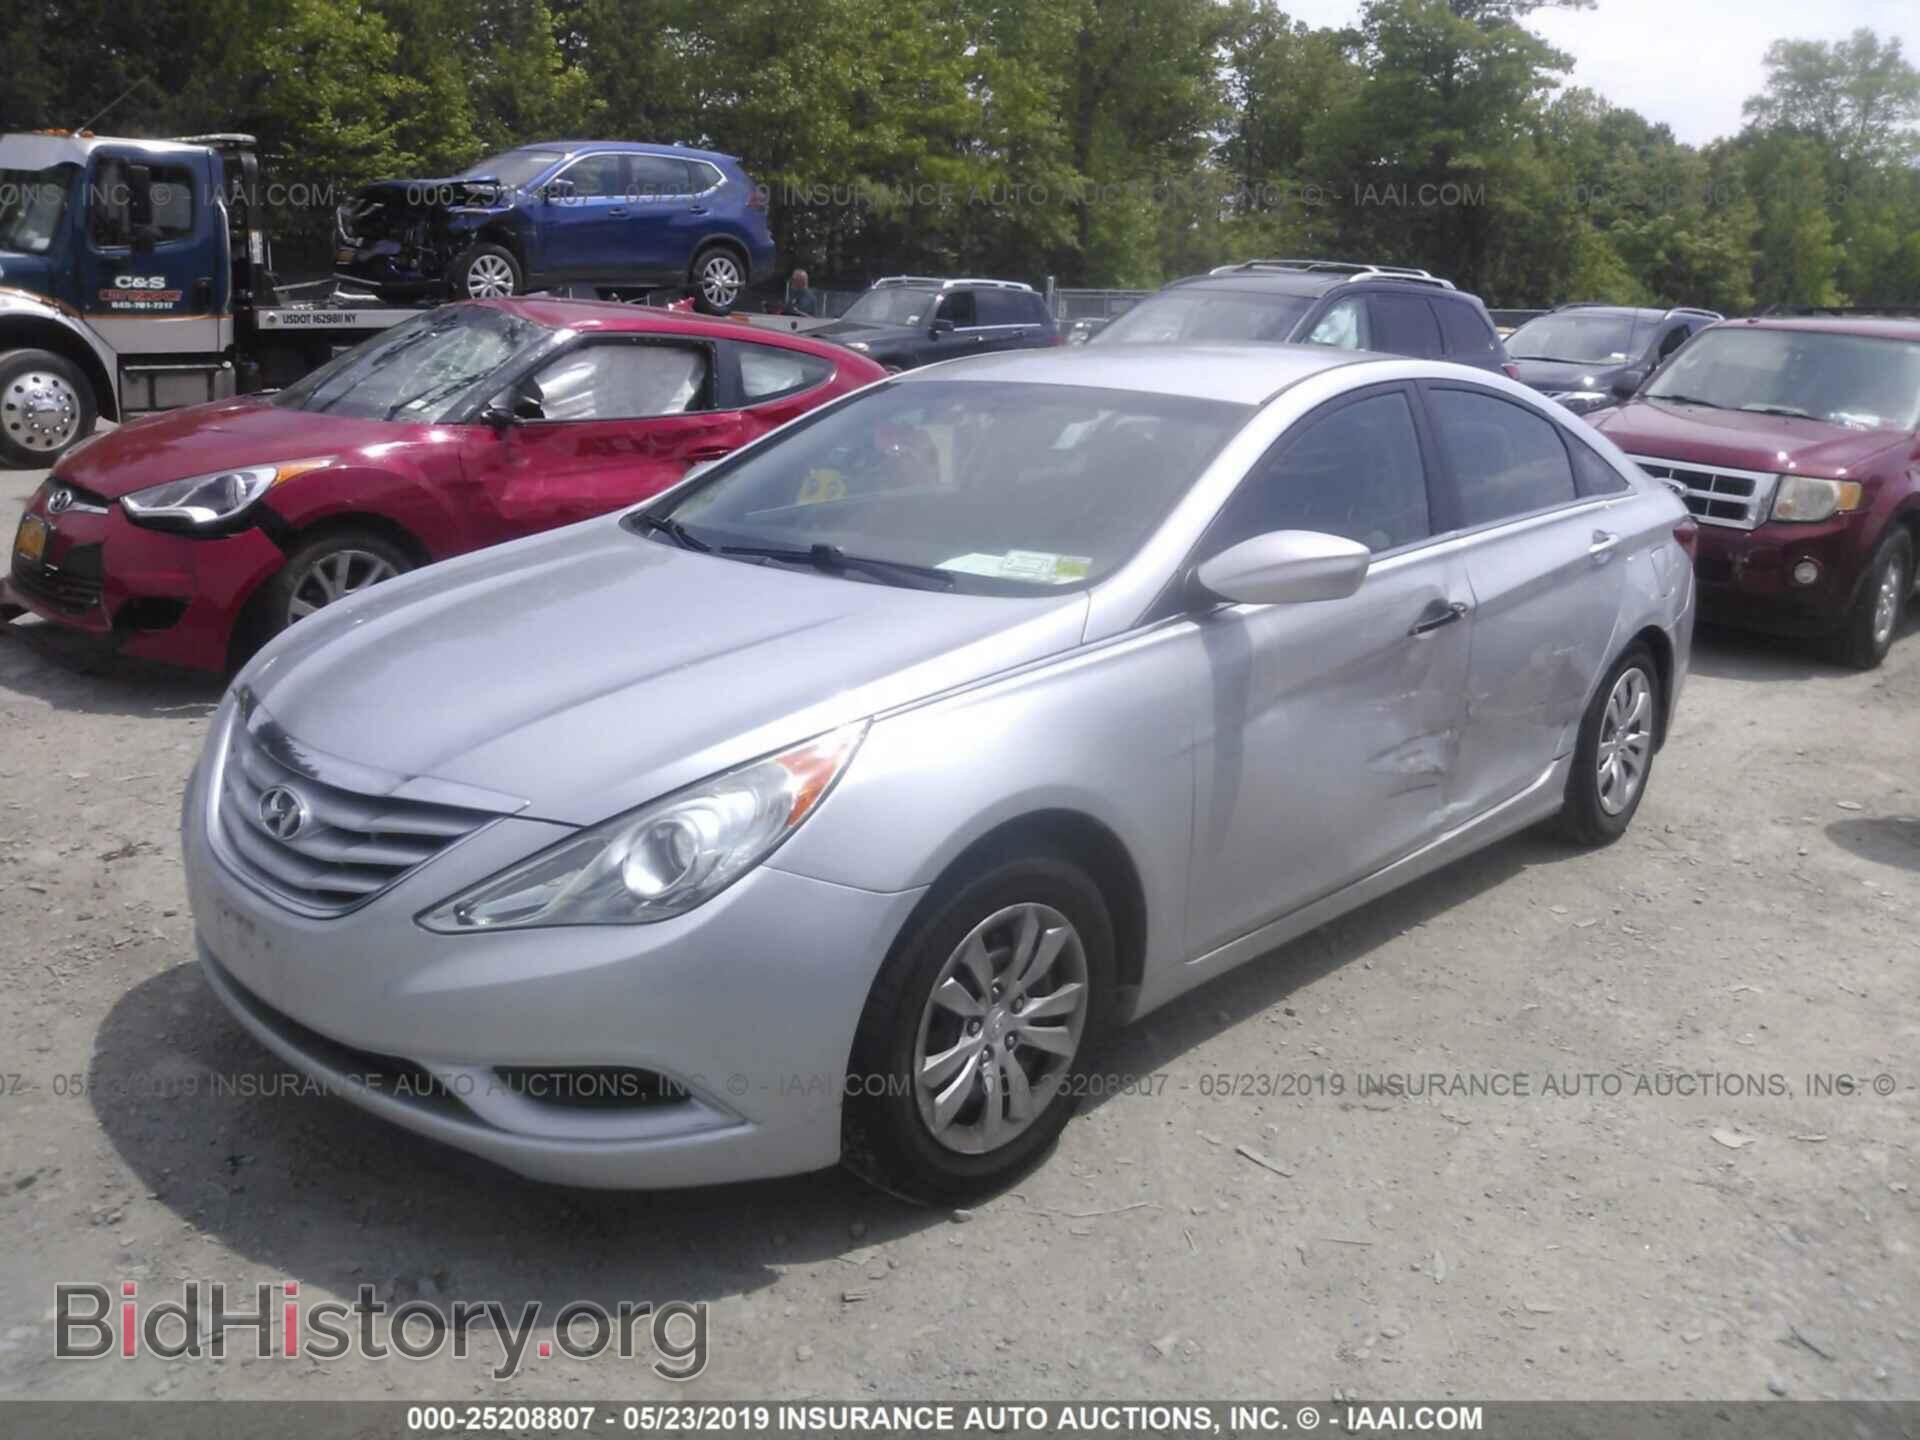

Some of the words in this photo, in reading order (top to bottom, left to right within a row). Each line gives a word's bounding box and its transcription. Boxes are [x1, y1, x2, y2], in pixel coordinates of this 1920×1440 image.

[115, 276, 166, 289] C&S
[282, 313, 311, 324] USDOT
[344, 313, 357, 323] NY
